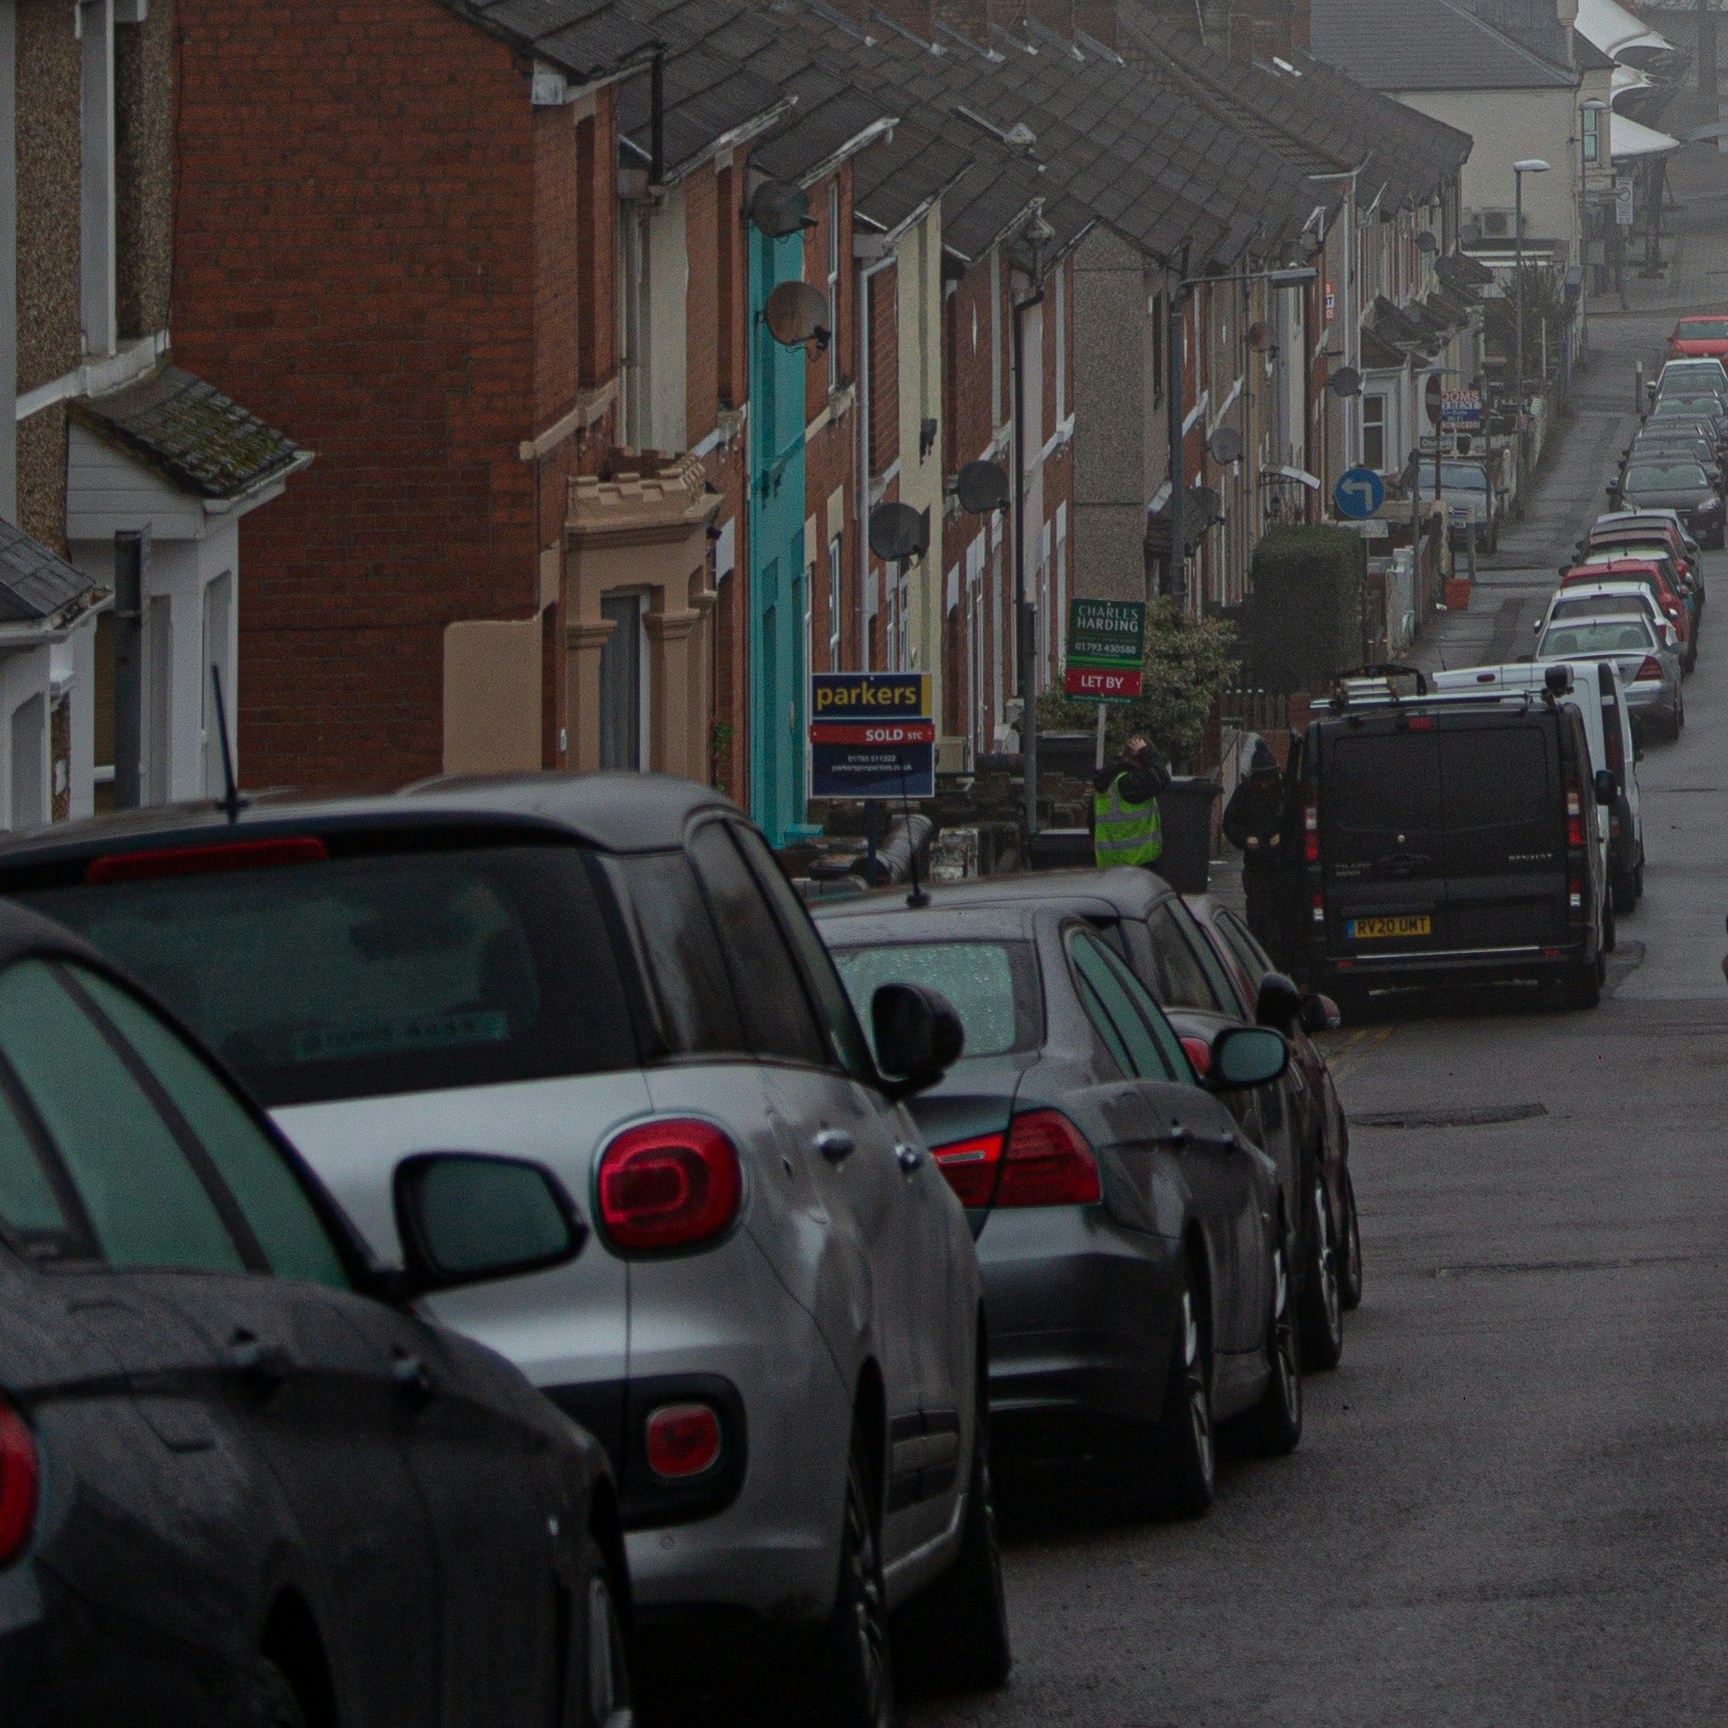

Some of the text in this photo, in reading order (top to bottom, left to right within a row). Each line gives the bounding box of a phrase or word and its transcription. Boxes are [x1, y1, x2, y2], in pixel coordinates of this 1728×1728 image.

[1441, 390, 1479, 402] OOMS
[1078, 605, 1139, 620] CHARLES
[1077, 617, 1139, 633] HARDING
[1074, 642, 1102, 652] 01793
[1081, 675, 1125, 689] LET BY
[816, 680, 917, 711] parkers
[865, 728, 923, 741] SOLD STC
[1357, 917, 1427, 935] RV20 UMT
